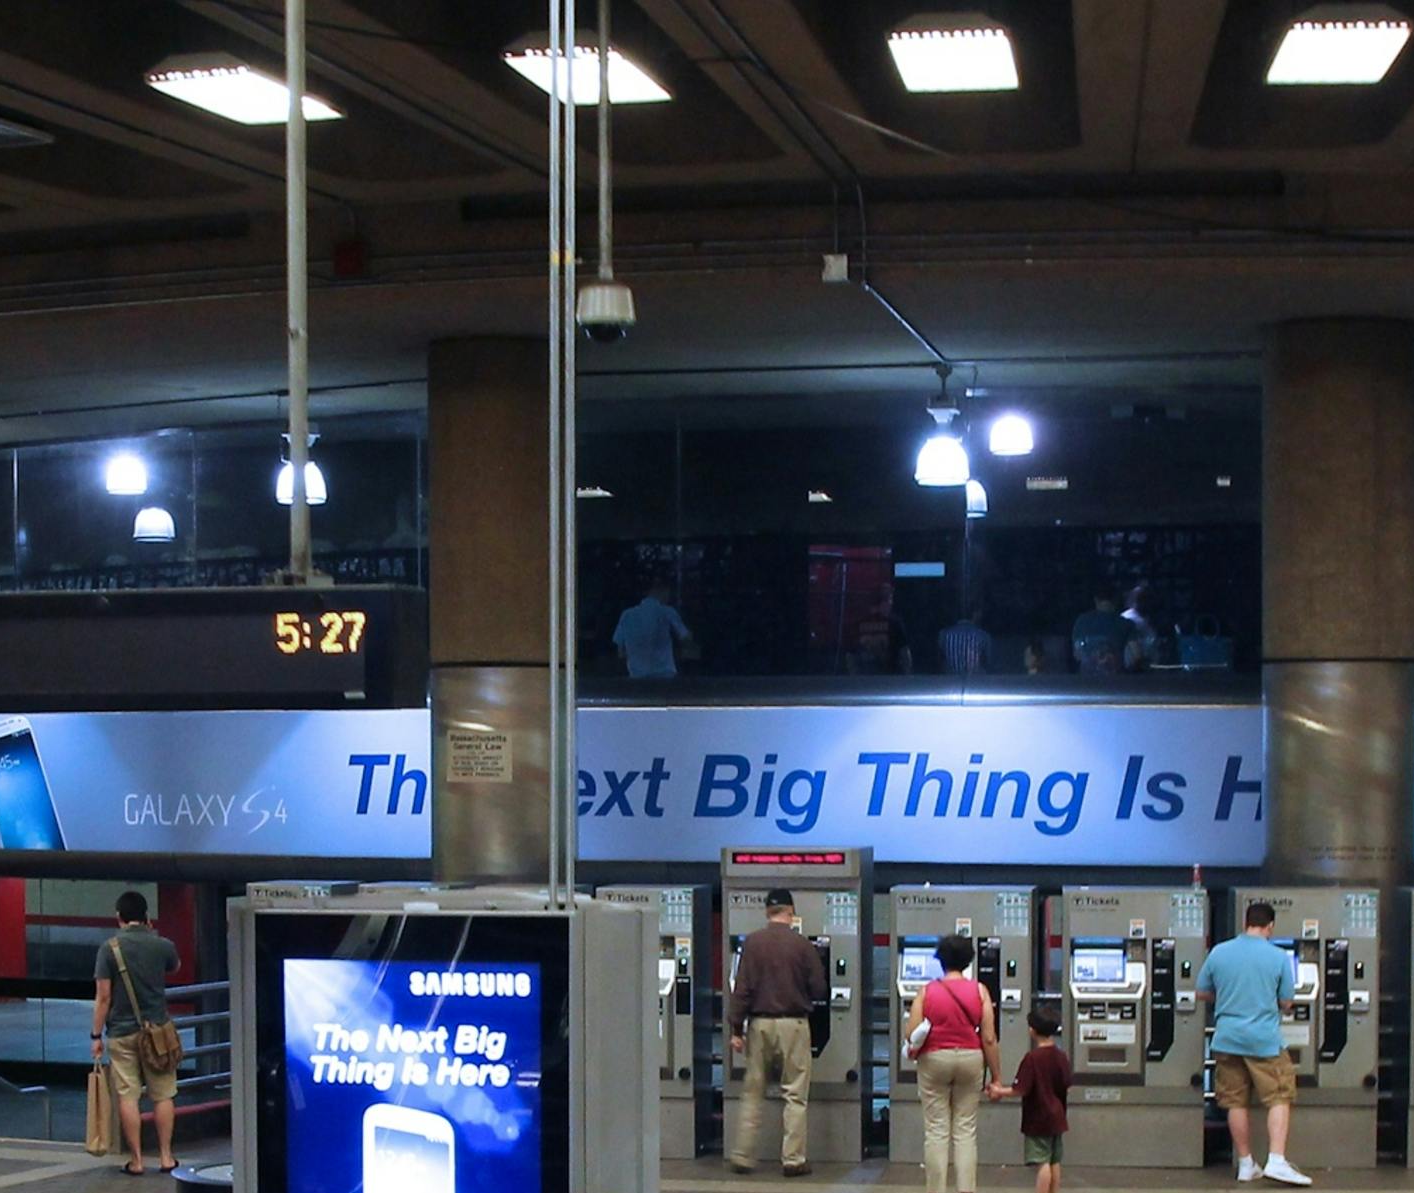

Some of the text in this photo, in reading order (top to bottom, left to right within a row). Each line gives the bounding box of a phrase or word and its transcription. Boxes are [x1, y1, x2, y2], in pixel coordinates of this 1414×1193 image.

[276, 612, 366, 654] 5:27
[124, 793, 236, 827] GALAXY
[348, 754, 428, 815] Th
[577, 757, 671, 818] ext
[693, 753, 828, 834] Big
[857, 752, 1089, 836] Thing
[1115, 755, 1187, 822] Is
[912, 895, 946, 905] Tickets
[1086, 896, 1120, 906] Tickets
[409, 971, 531, 998] SAMSUNG
[313, 1023, 507, 1060] The Next Big
[310, 1055, 511, 1091] Thing Is Here
